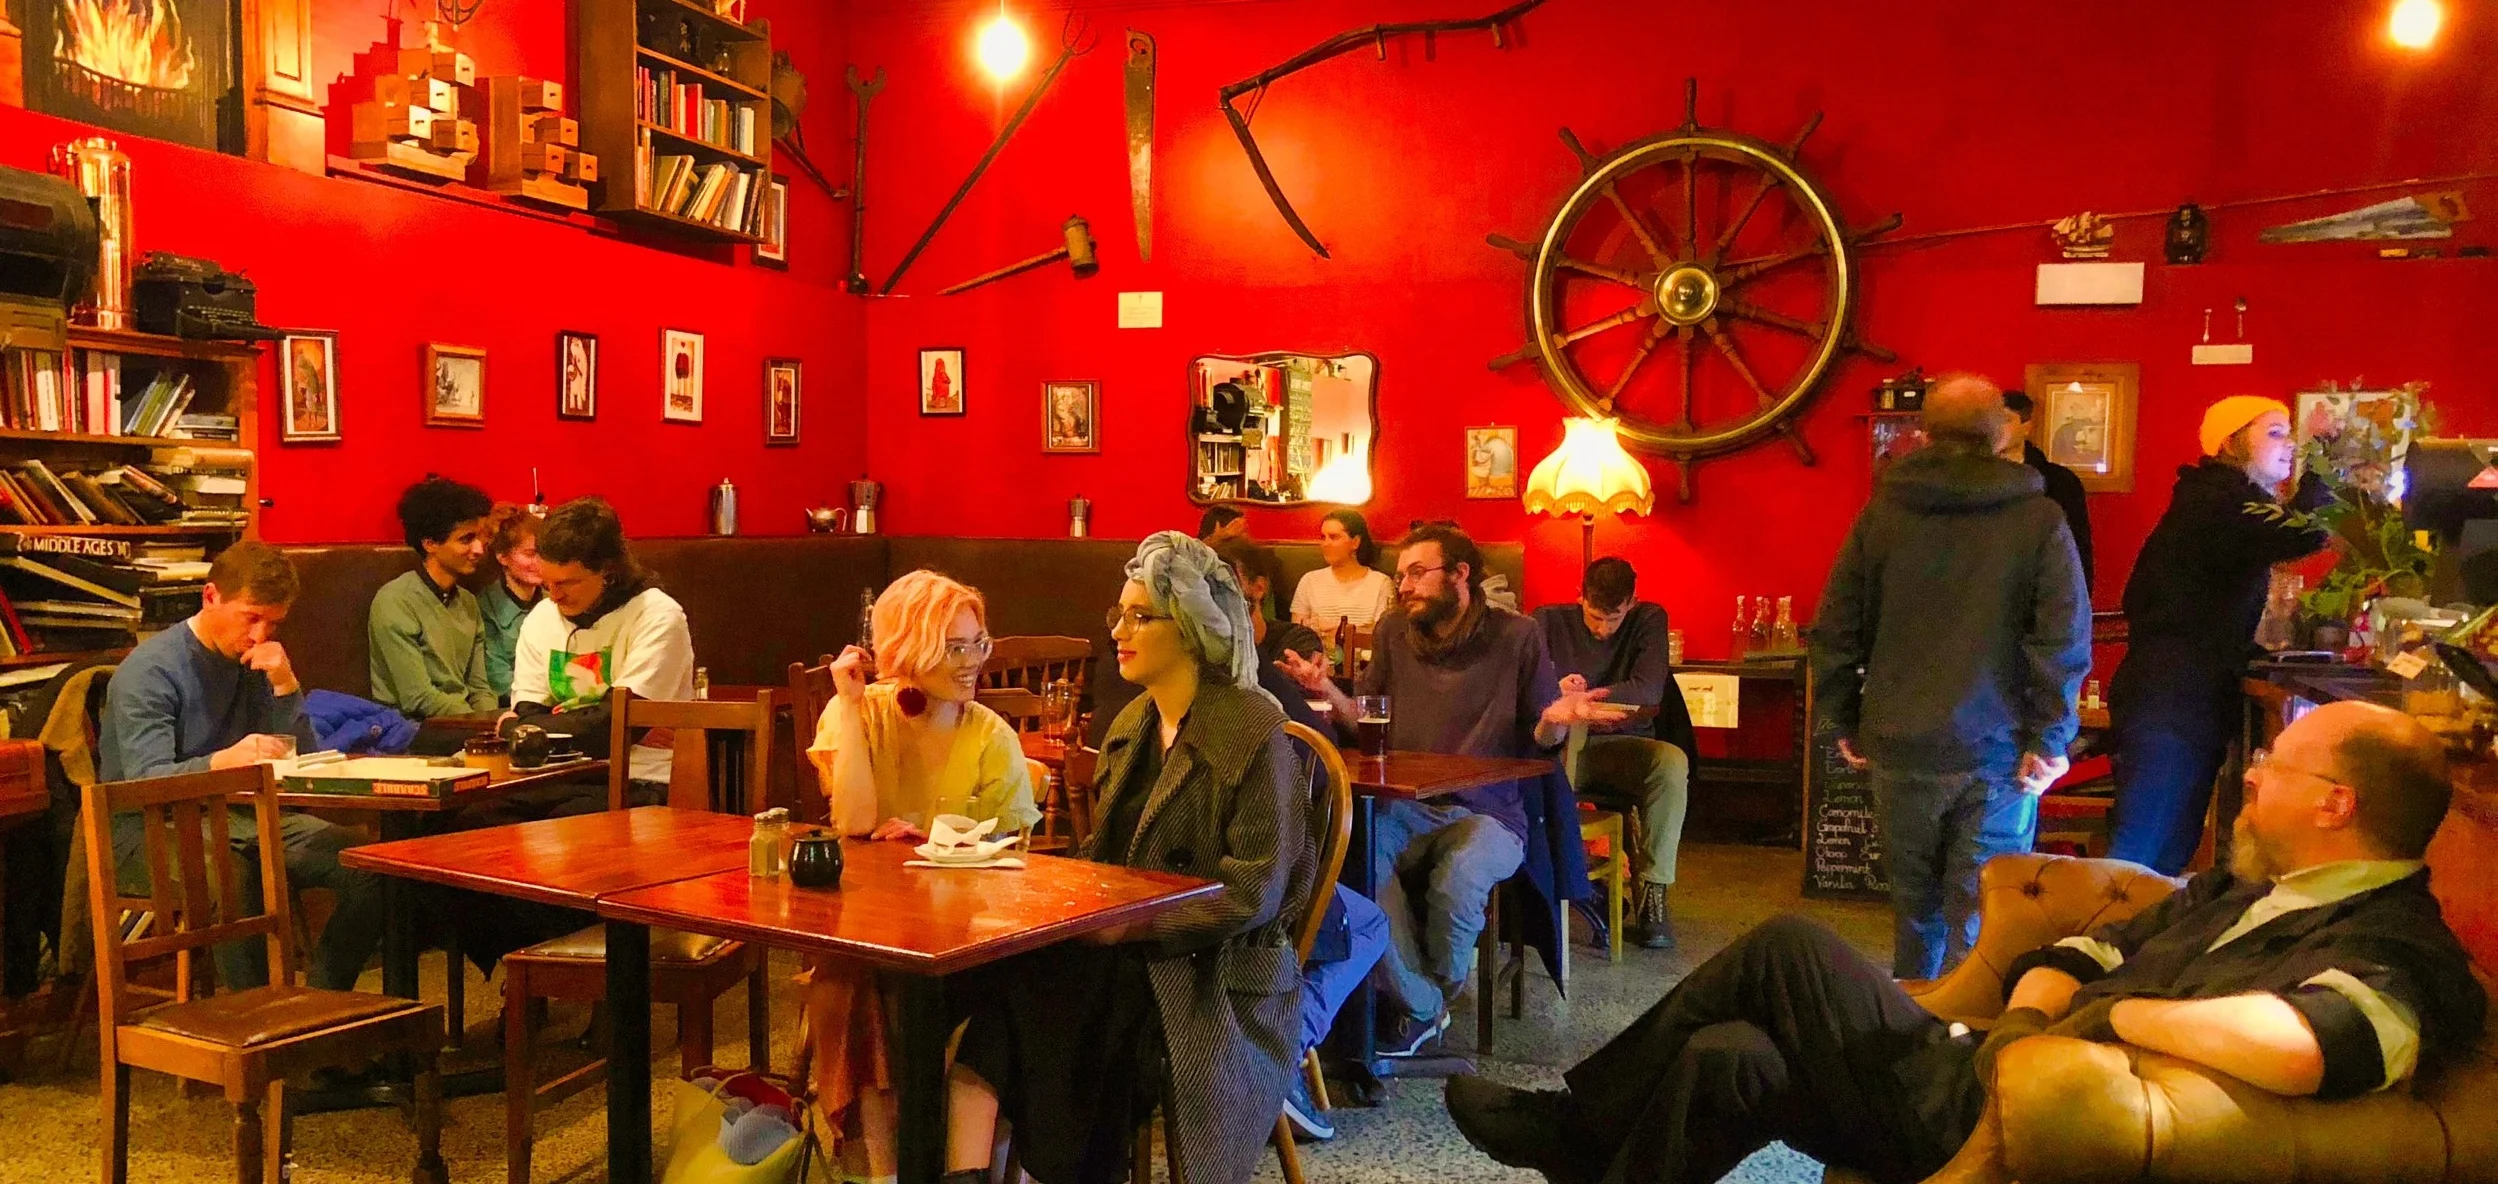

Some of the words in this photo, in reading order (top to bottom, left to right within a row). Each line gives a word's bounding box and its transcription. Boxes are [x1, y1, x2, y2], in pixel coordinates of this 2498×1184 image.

[33, 537, 81, 553] MIDDLE
[82, 540, 114, 556] AGES
[1816, 832, 1852, 847] Lemon
[1815, 857, 1872, 877] Peppermint
